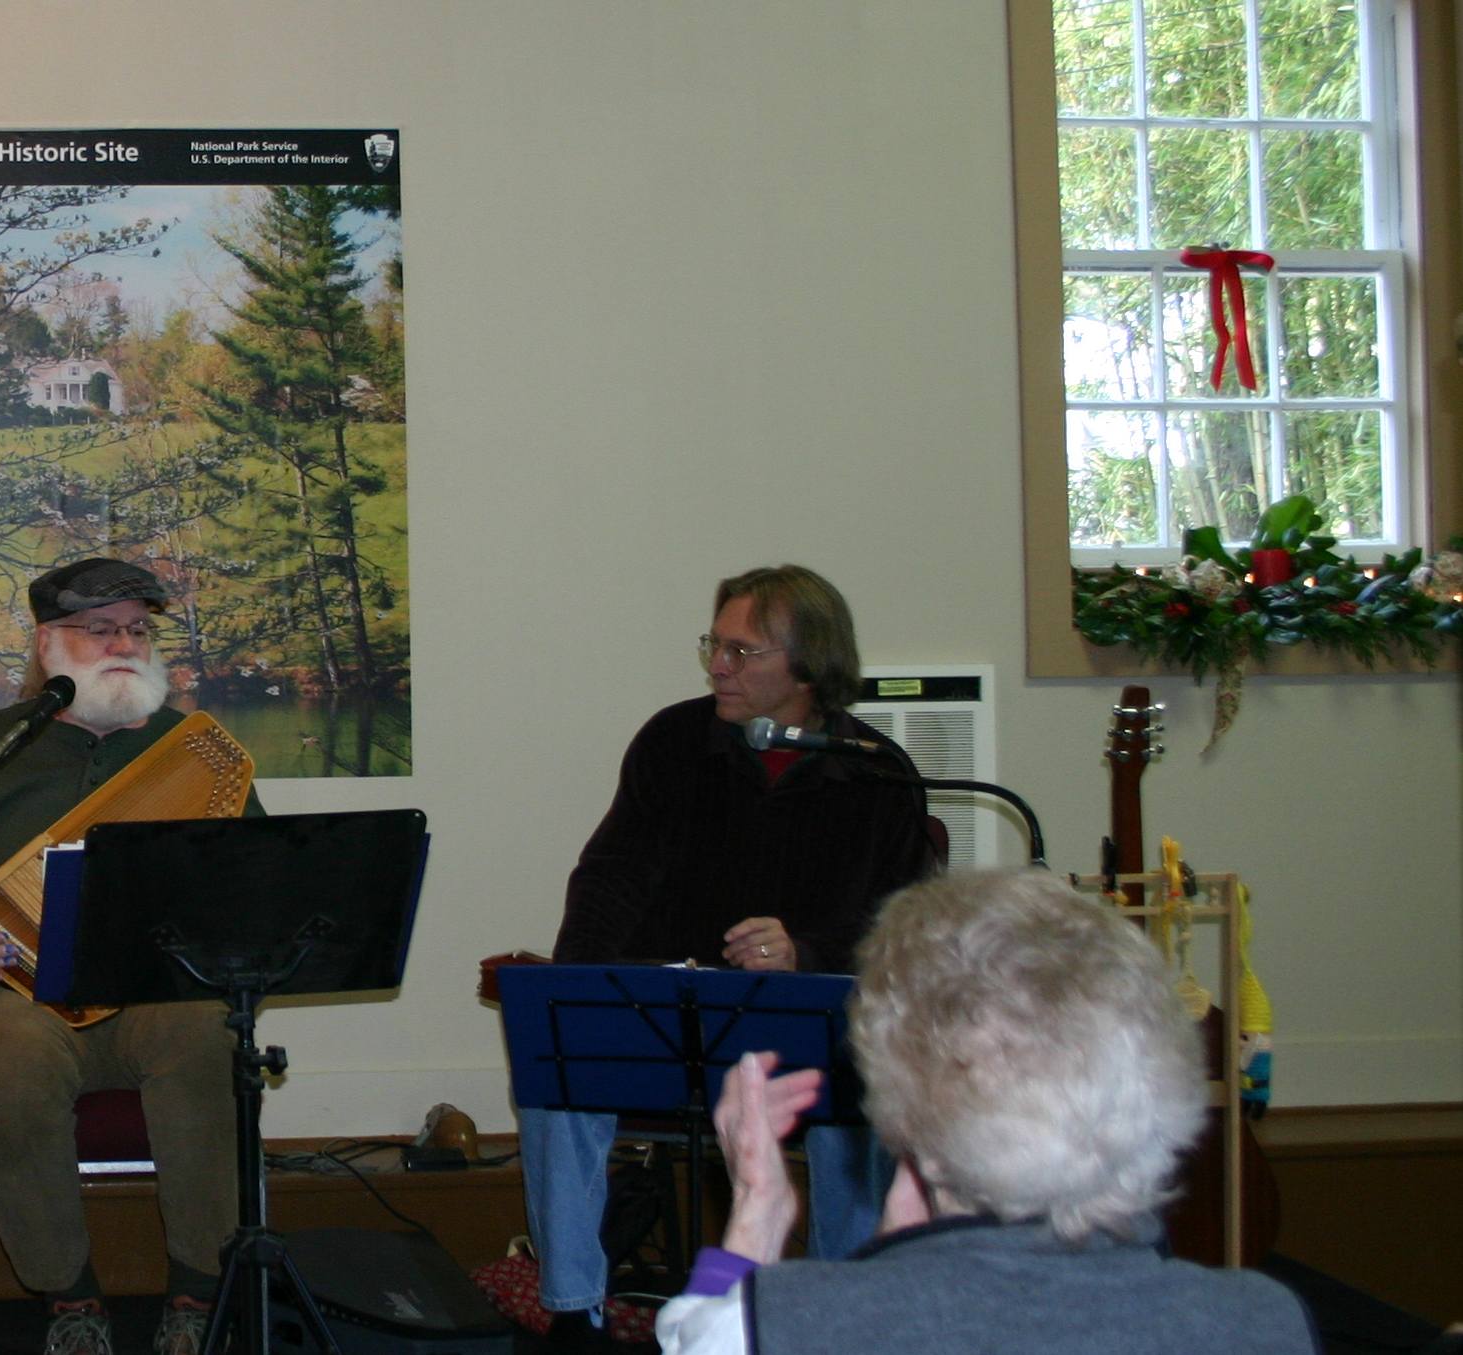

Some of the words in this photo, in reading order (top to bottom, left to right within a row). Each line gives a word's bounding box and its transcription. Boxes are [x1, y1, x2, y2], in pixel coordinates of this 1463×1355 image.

[190, 141, 234, 151] National
[236, 141, 259, 150] Park
[262, 141, 298, 150] Service
[94, 142, 139, 162] Site
[191, 155, 210, 164] U.S.
[213, 155, 275, 165] Department
[277, 154, 288, 163] of
[292, 154, 308, 163] the
[311, 154, 349, 163] Interior
